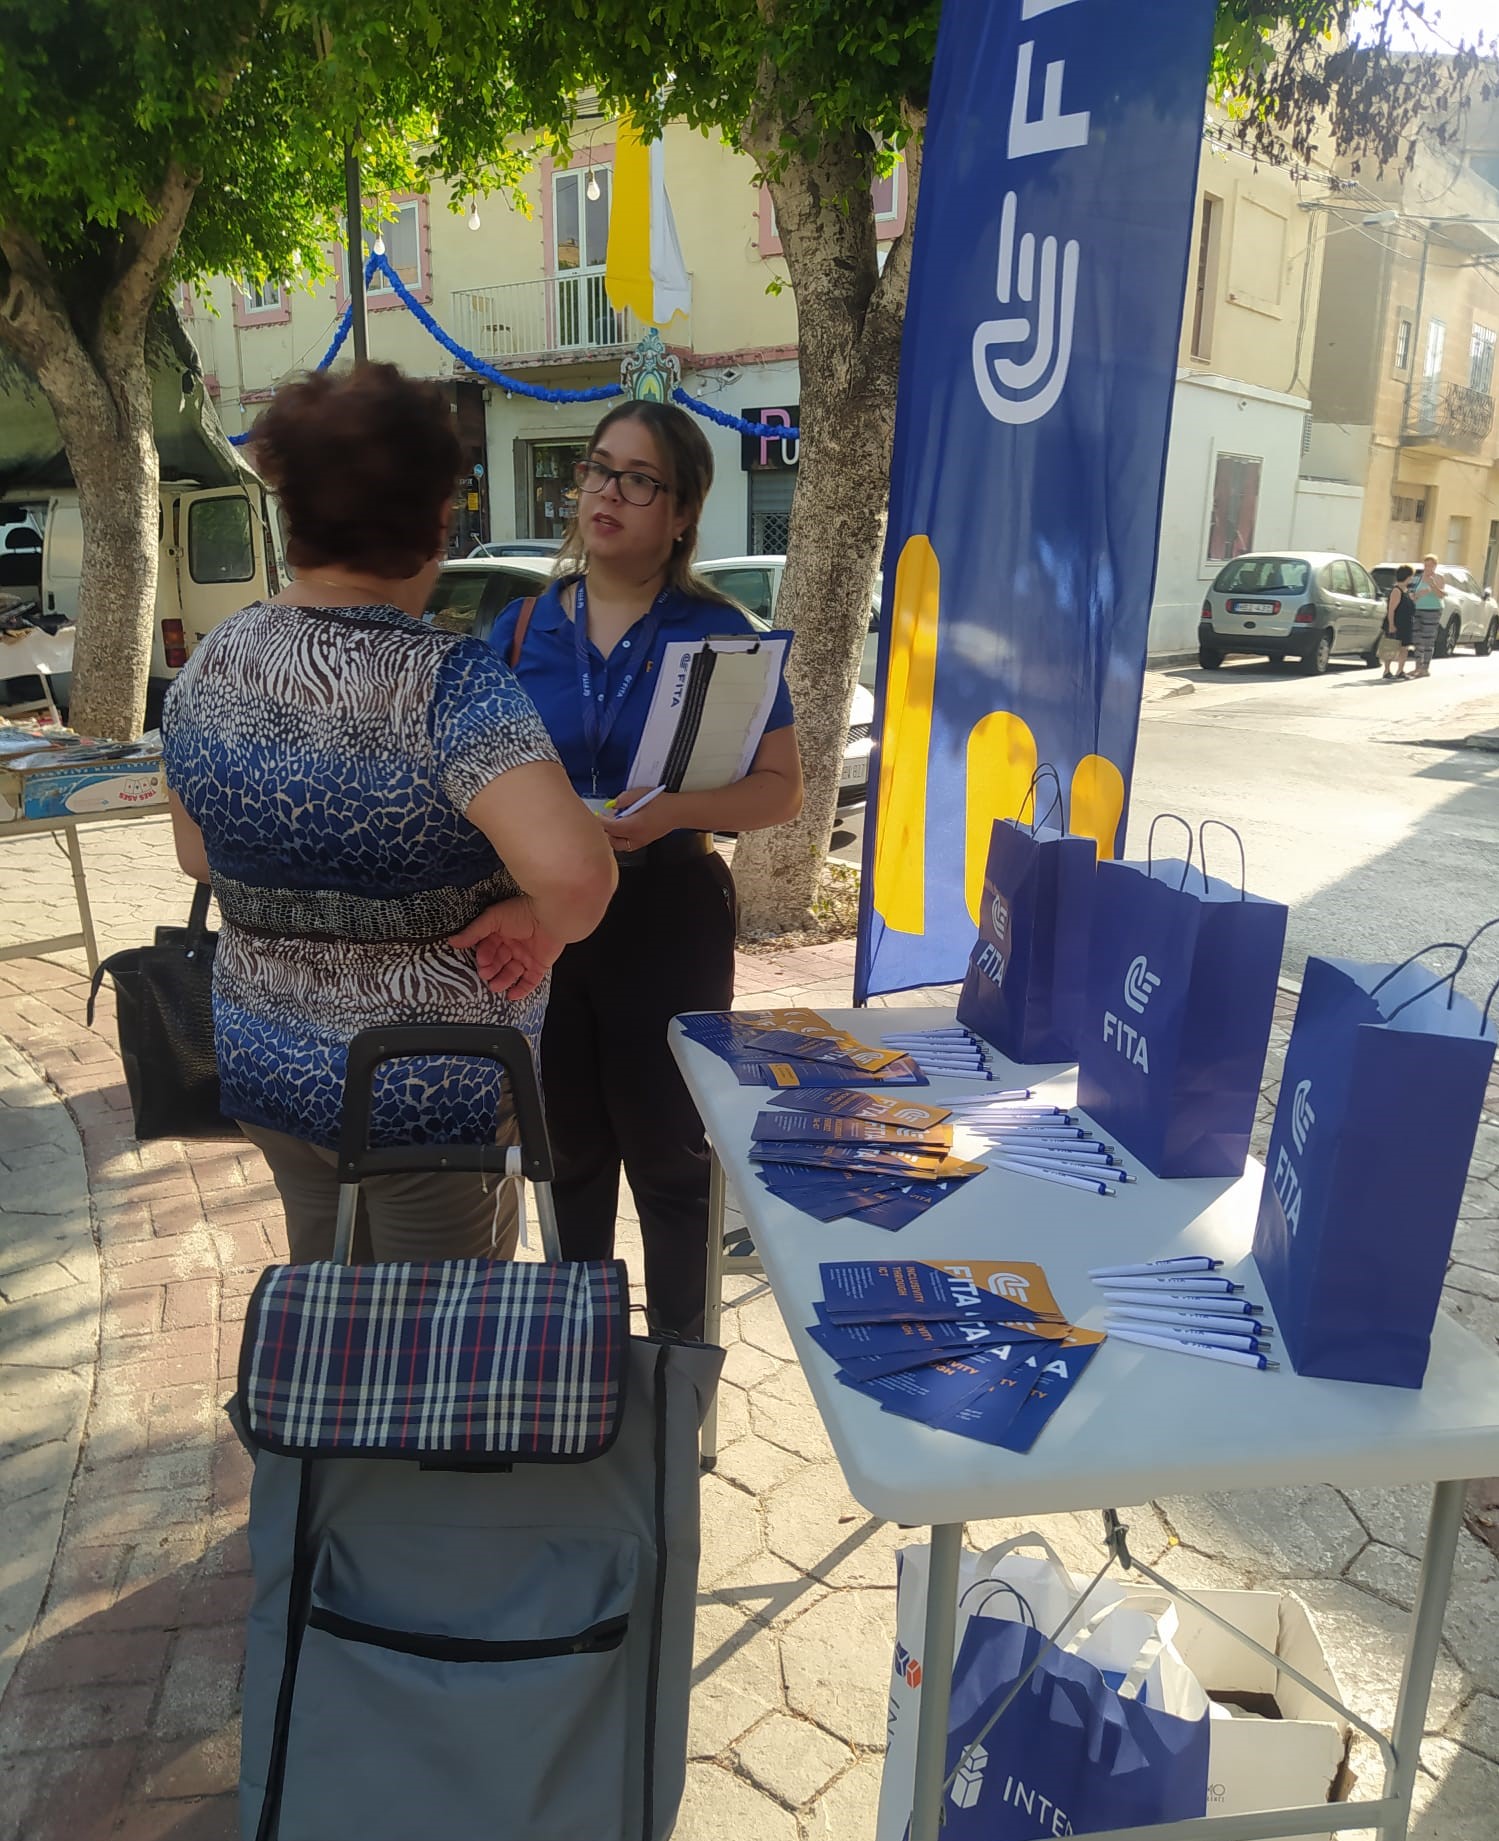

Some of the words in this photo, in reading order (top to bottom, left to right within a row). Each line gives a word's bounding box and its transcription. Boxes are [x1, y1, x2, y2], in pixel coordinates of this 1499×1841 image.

[670, 673, 686, 708] FITA
[118, 792, 137, 802] ASES
[139, 789, 156, 801] TRES
[976, 943, 1005, 988] FITA
[1103, 1011, 1150, 1075] FITA
[855, 1099, 897, 1117] FITA
[1273, 1145, 1302, 1237] FITA
[878, 1266, 889, 1277] ICT
[892, 1266, 908, 1296] THROUGH
[906, 1266, 924, 1303] INCLUSIVITY
[943, 1265, 982, 1307] FITA
